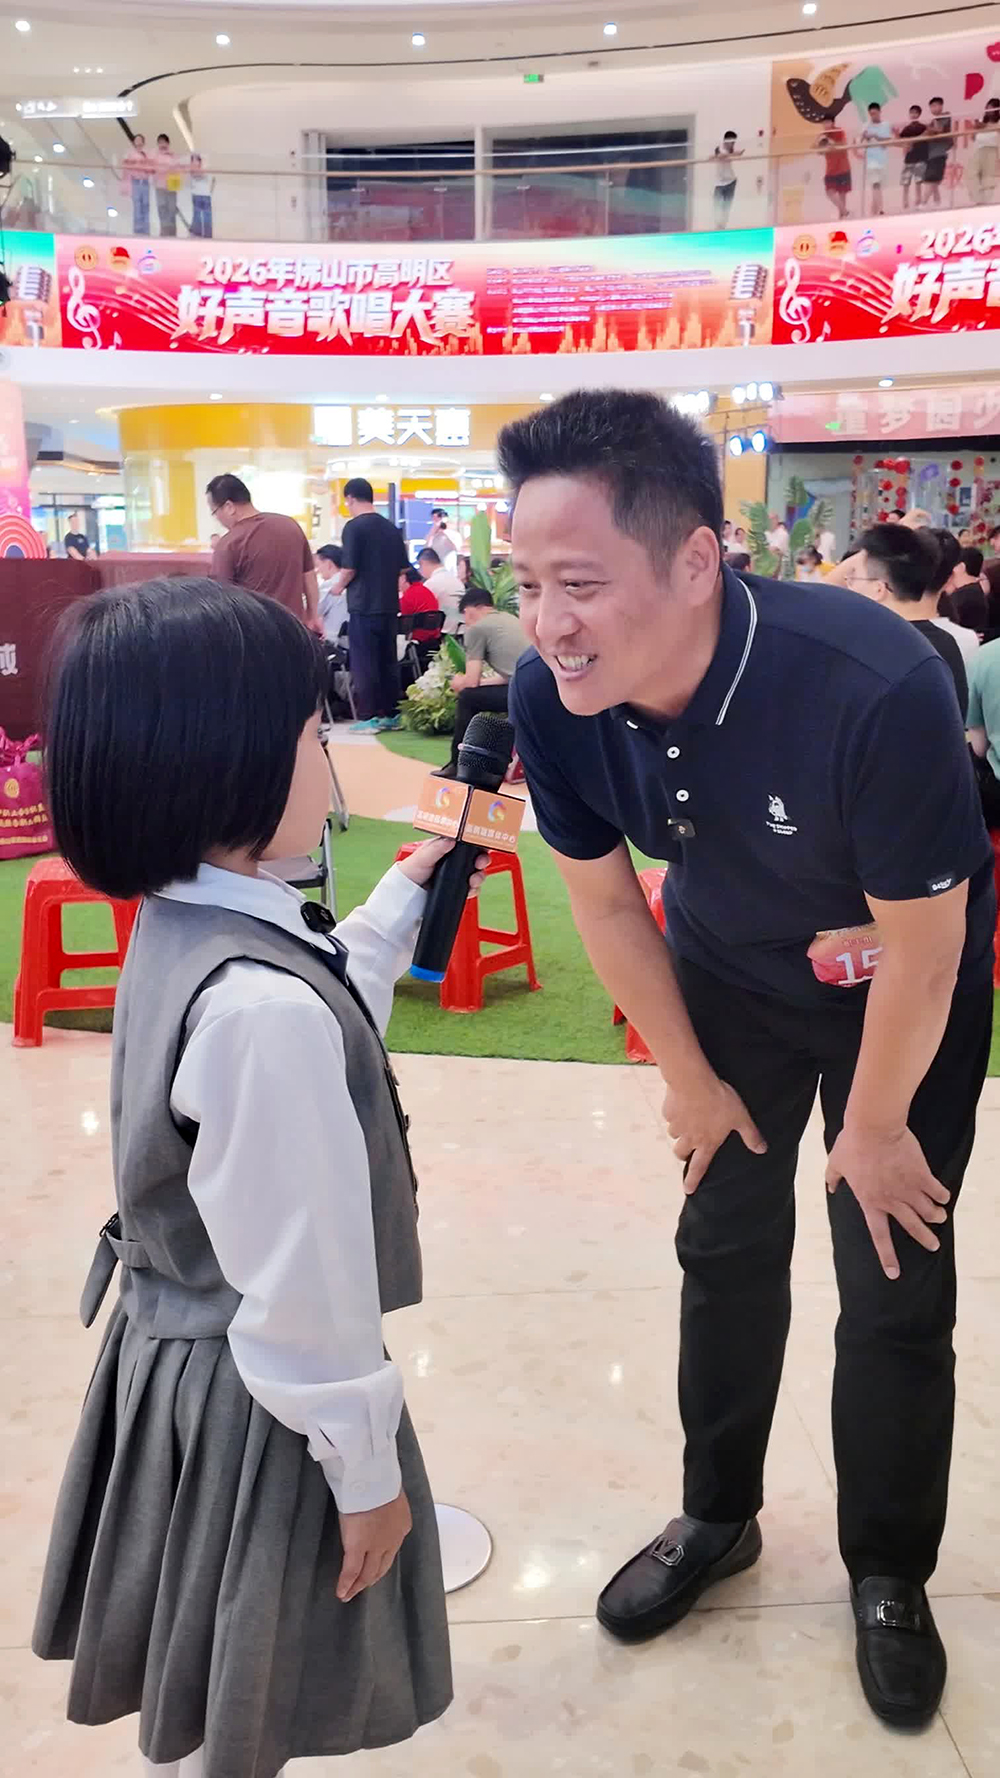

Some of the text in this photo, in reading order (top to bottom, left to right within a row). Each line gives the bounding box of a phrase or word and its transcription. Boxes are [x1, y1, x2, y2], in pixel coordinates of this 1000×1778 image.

[198, 256, 455, 291] 2026年佛山市高明区
[170, 284, 477, 346] 好声音歌唱大赛
